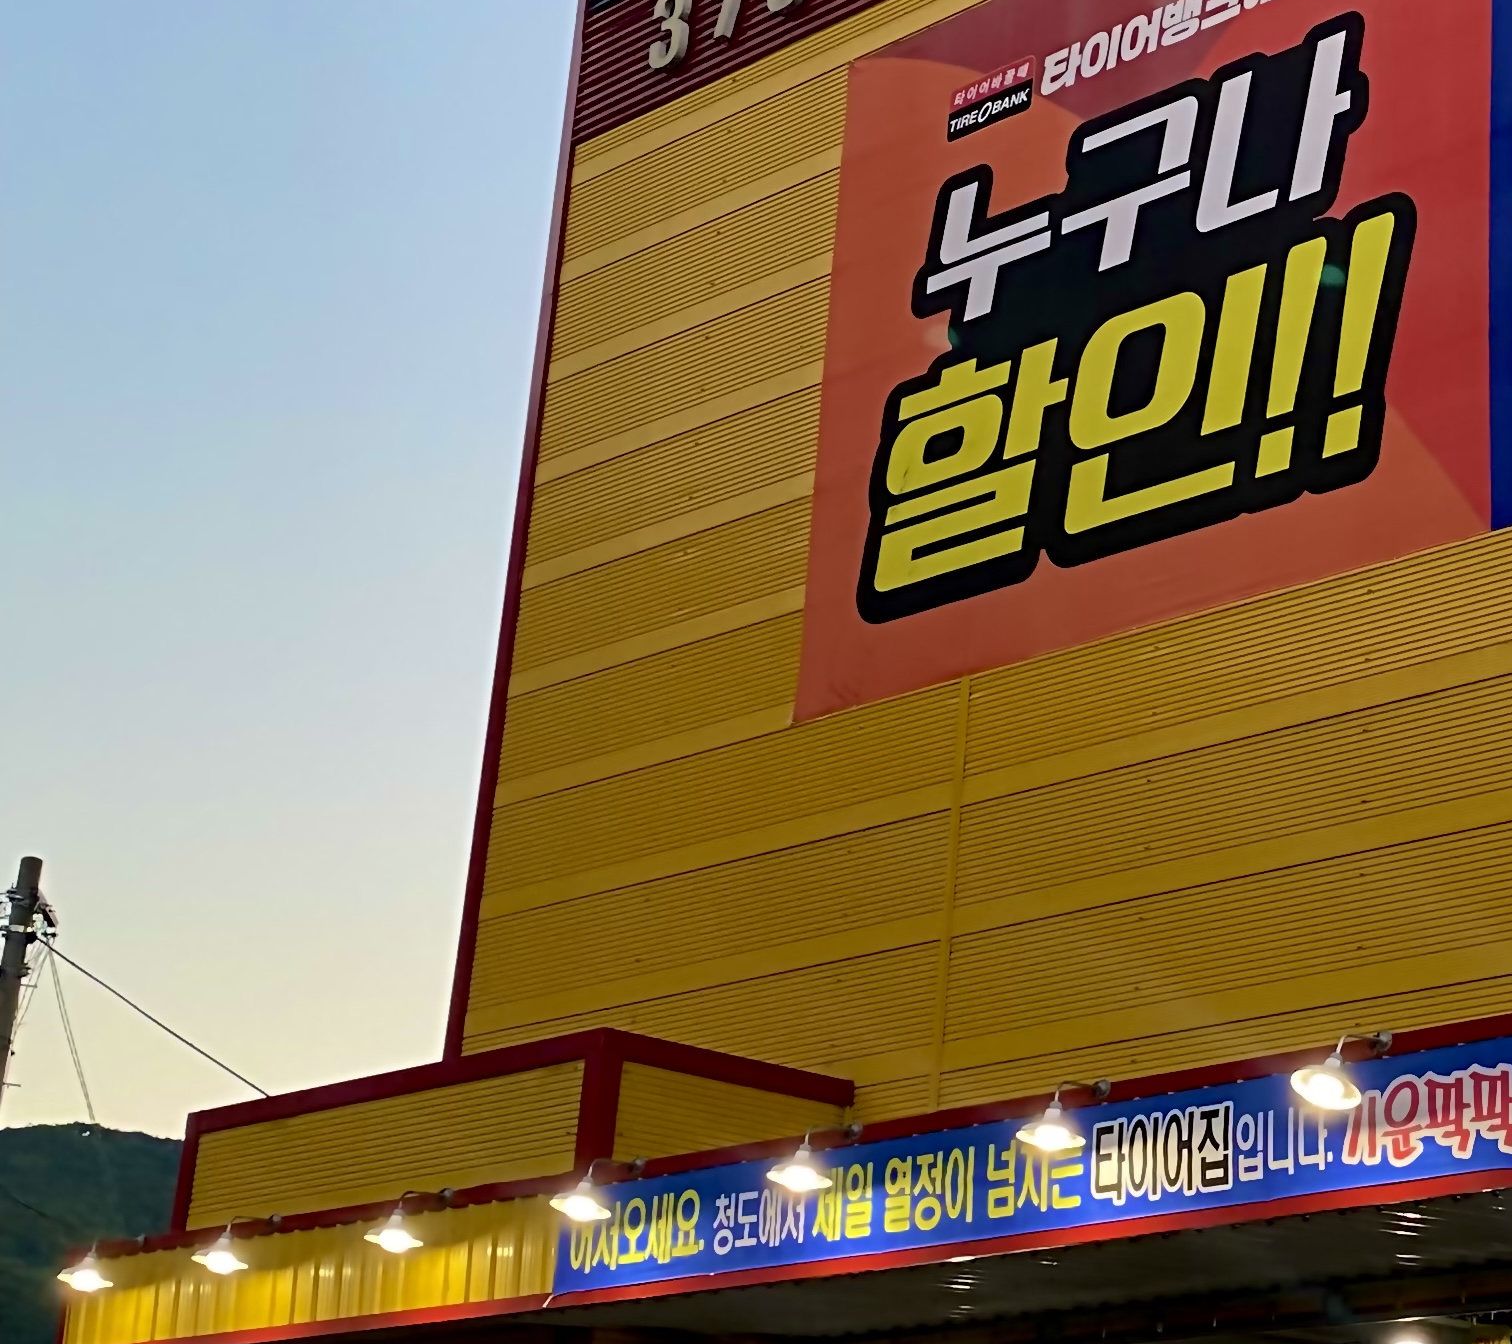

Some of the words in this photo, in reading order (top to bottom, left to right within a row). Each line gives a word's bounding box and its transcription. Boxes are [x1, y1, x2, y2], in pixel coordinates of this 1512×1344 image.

[926, 30, 1351, 322] 누구나
[873, 212, 1395, 592] 할인!!
[712, 1188, 807, 1256] 청도에서
[884, 1145, 975, 1233] 열정이
